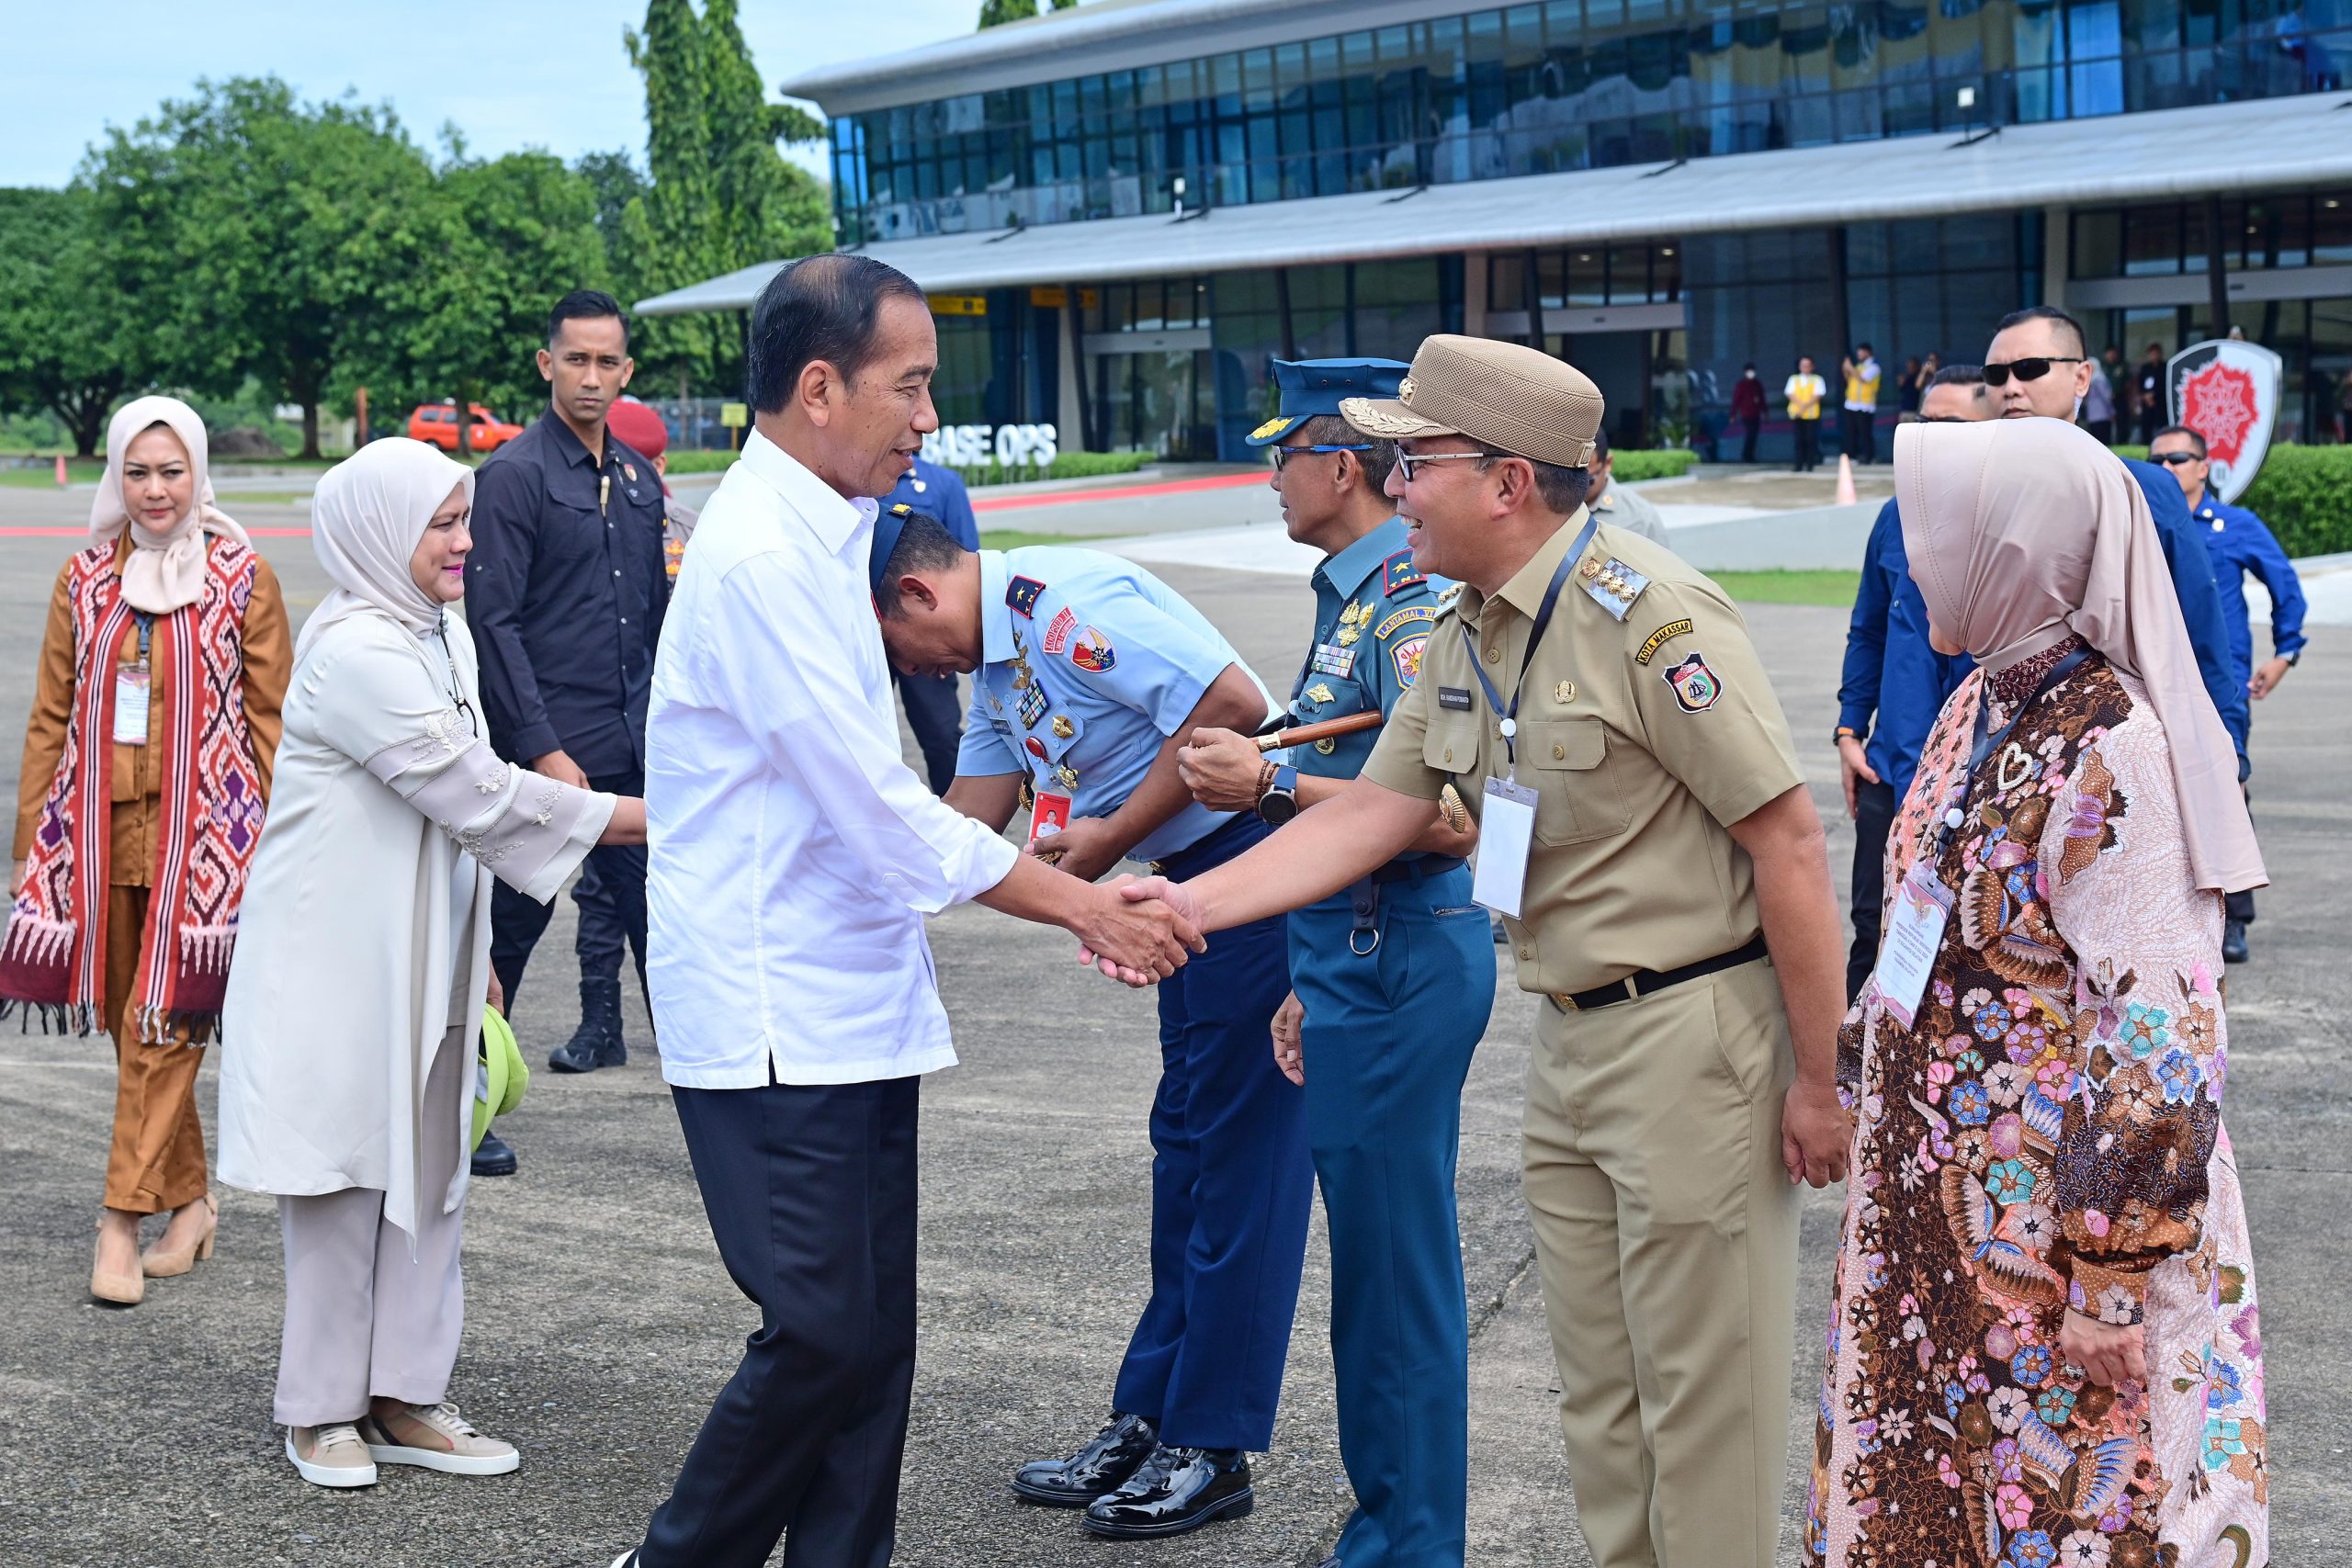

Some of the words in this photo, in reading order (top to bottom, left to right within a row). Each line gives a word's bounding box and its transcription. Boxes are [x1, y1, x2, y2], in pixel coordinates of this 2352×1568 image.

[920, 424, 992, 467] BASE
[995, 423, 1057, 467] OPS
[1046, 617, 1063, 650] KOOPSUD
[1638, 643, 1656, 662] KOTA
[1653, 622, 1690, 644] MAKASSAR
